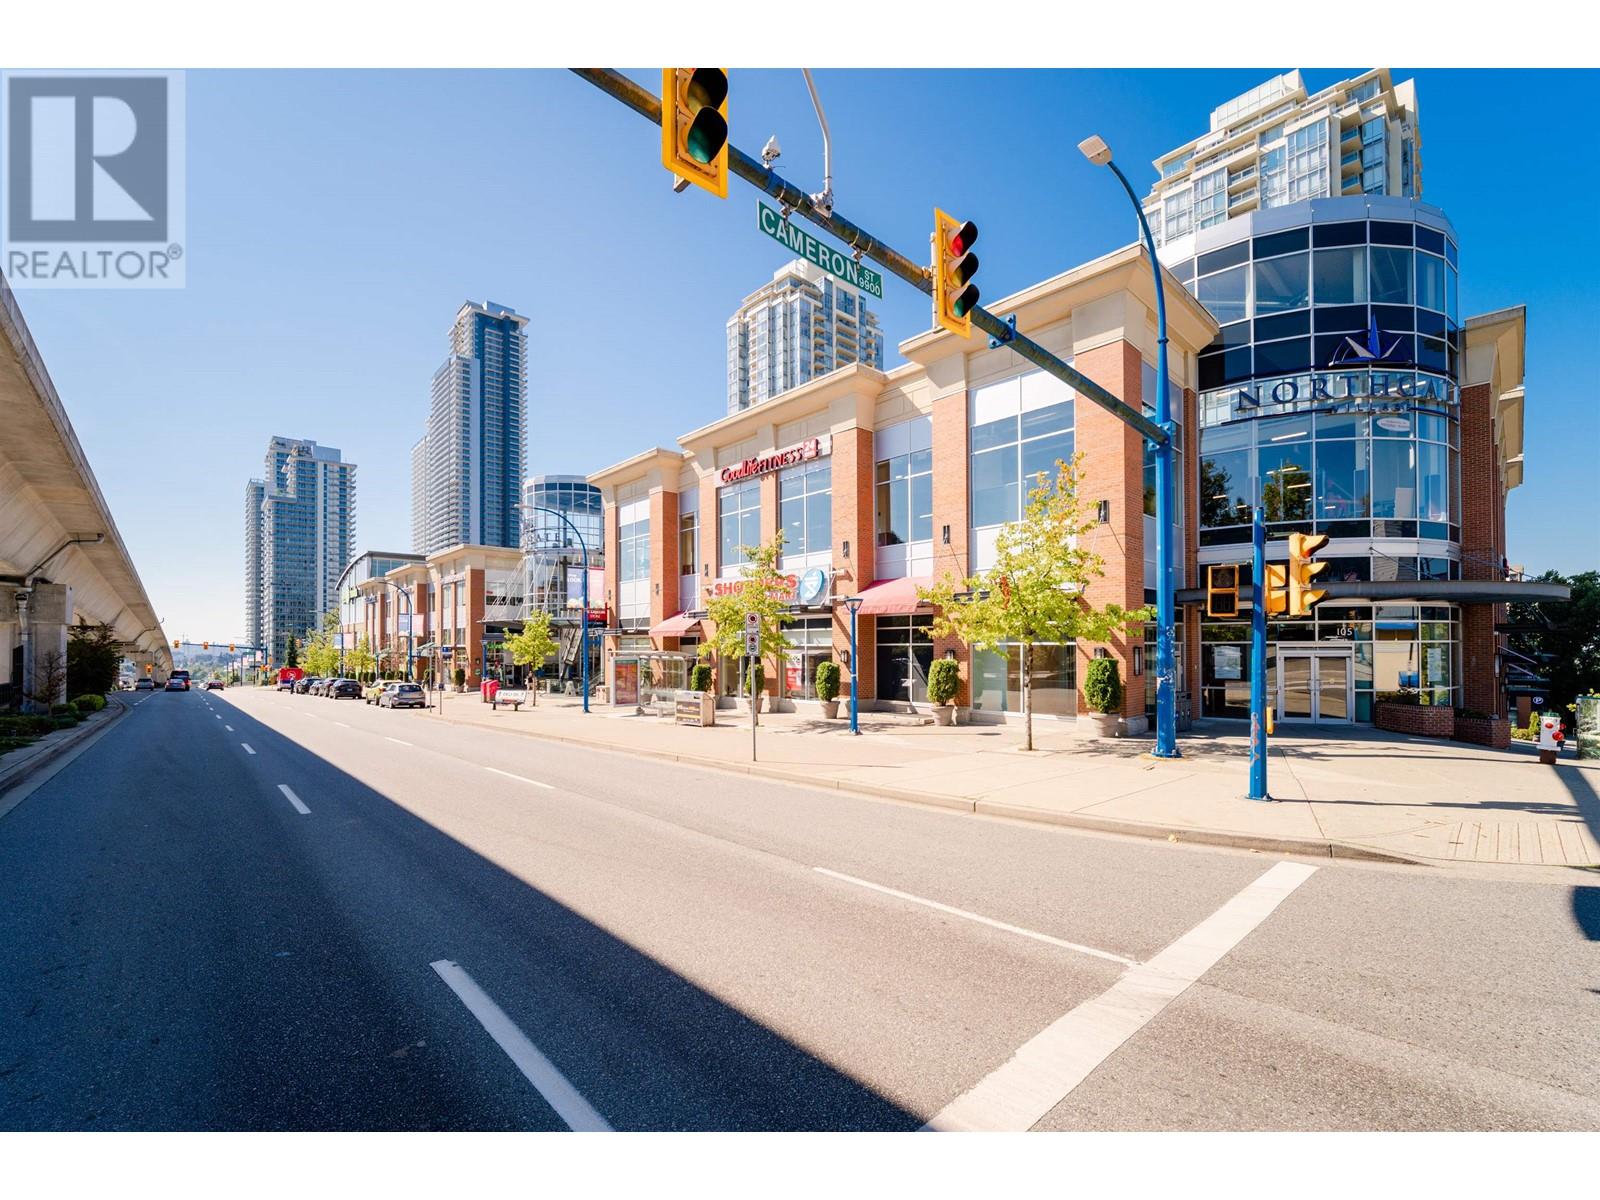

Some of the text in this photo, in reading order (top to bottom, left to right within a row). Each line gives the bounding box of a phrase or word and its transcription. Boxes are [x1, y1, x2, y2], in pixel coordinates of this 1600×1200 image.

[761, 207, 859, 285] CAMERON
[858, 276, 881, 296] 9900
[864, 270, 876, 283] ST
[758, 447, 804, 473] FITNESS
[1336, 627, 1353, 636] 105
